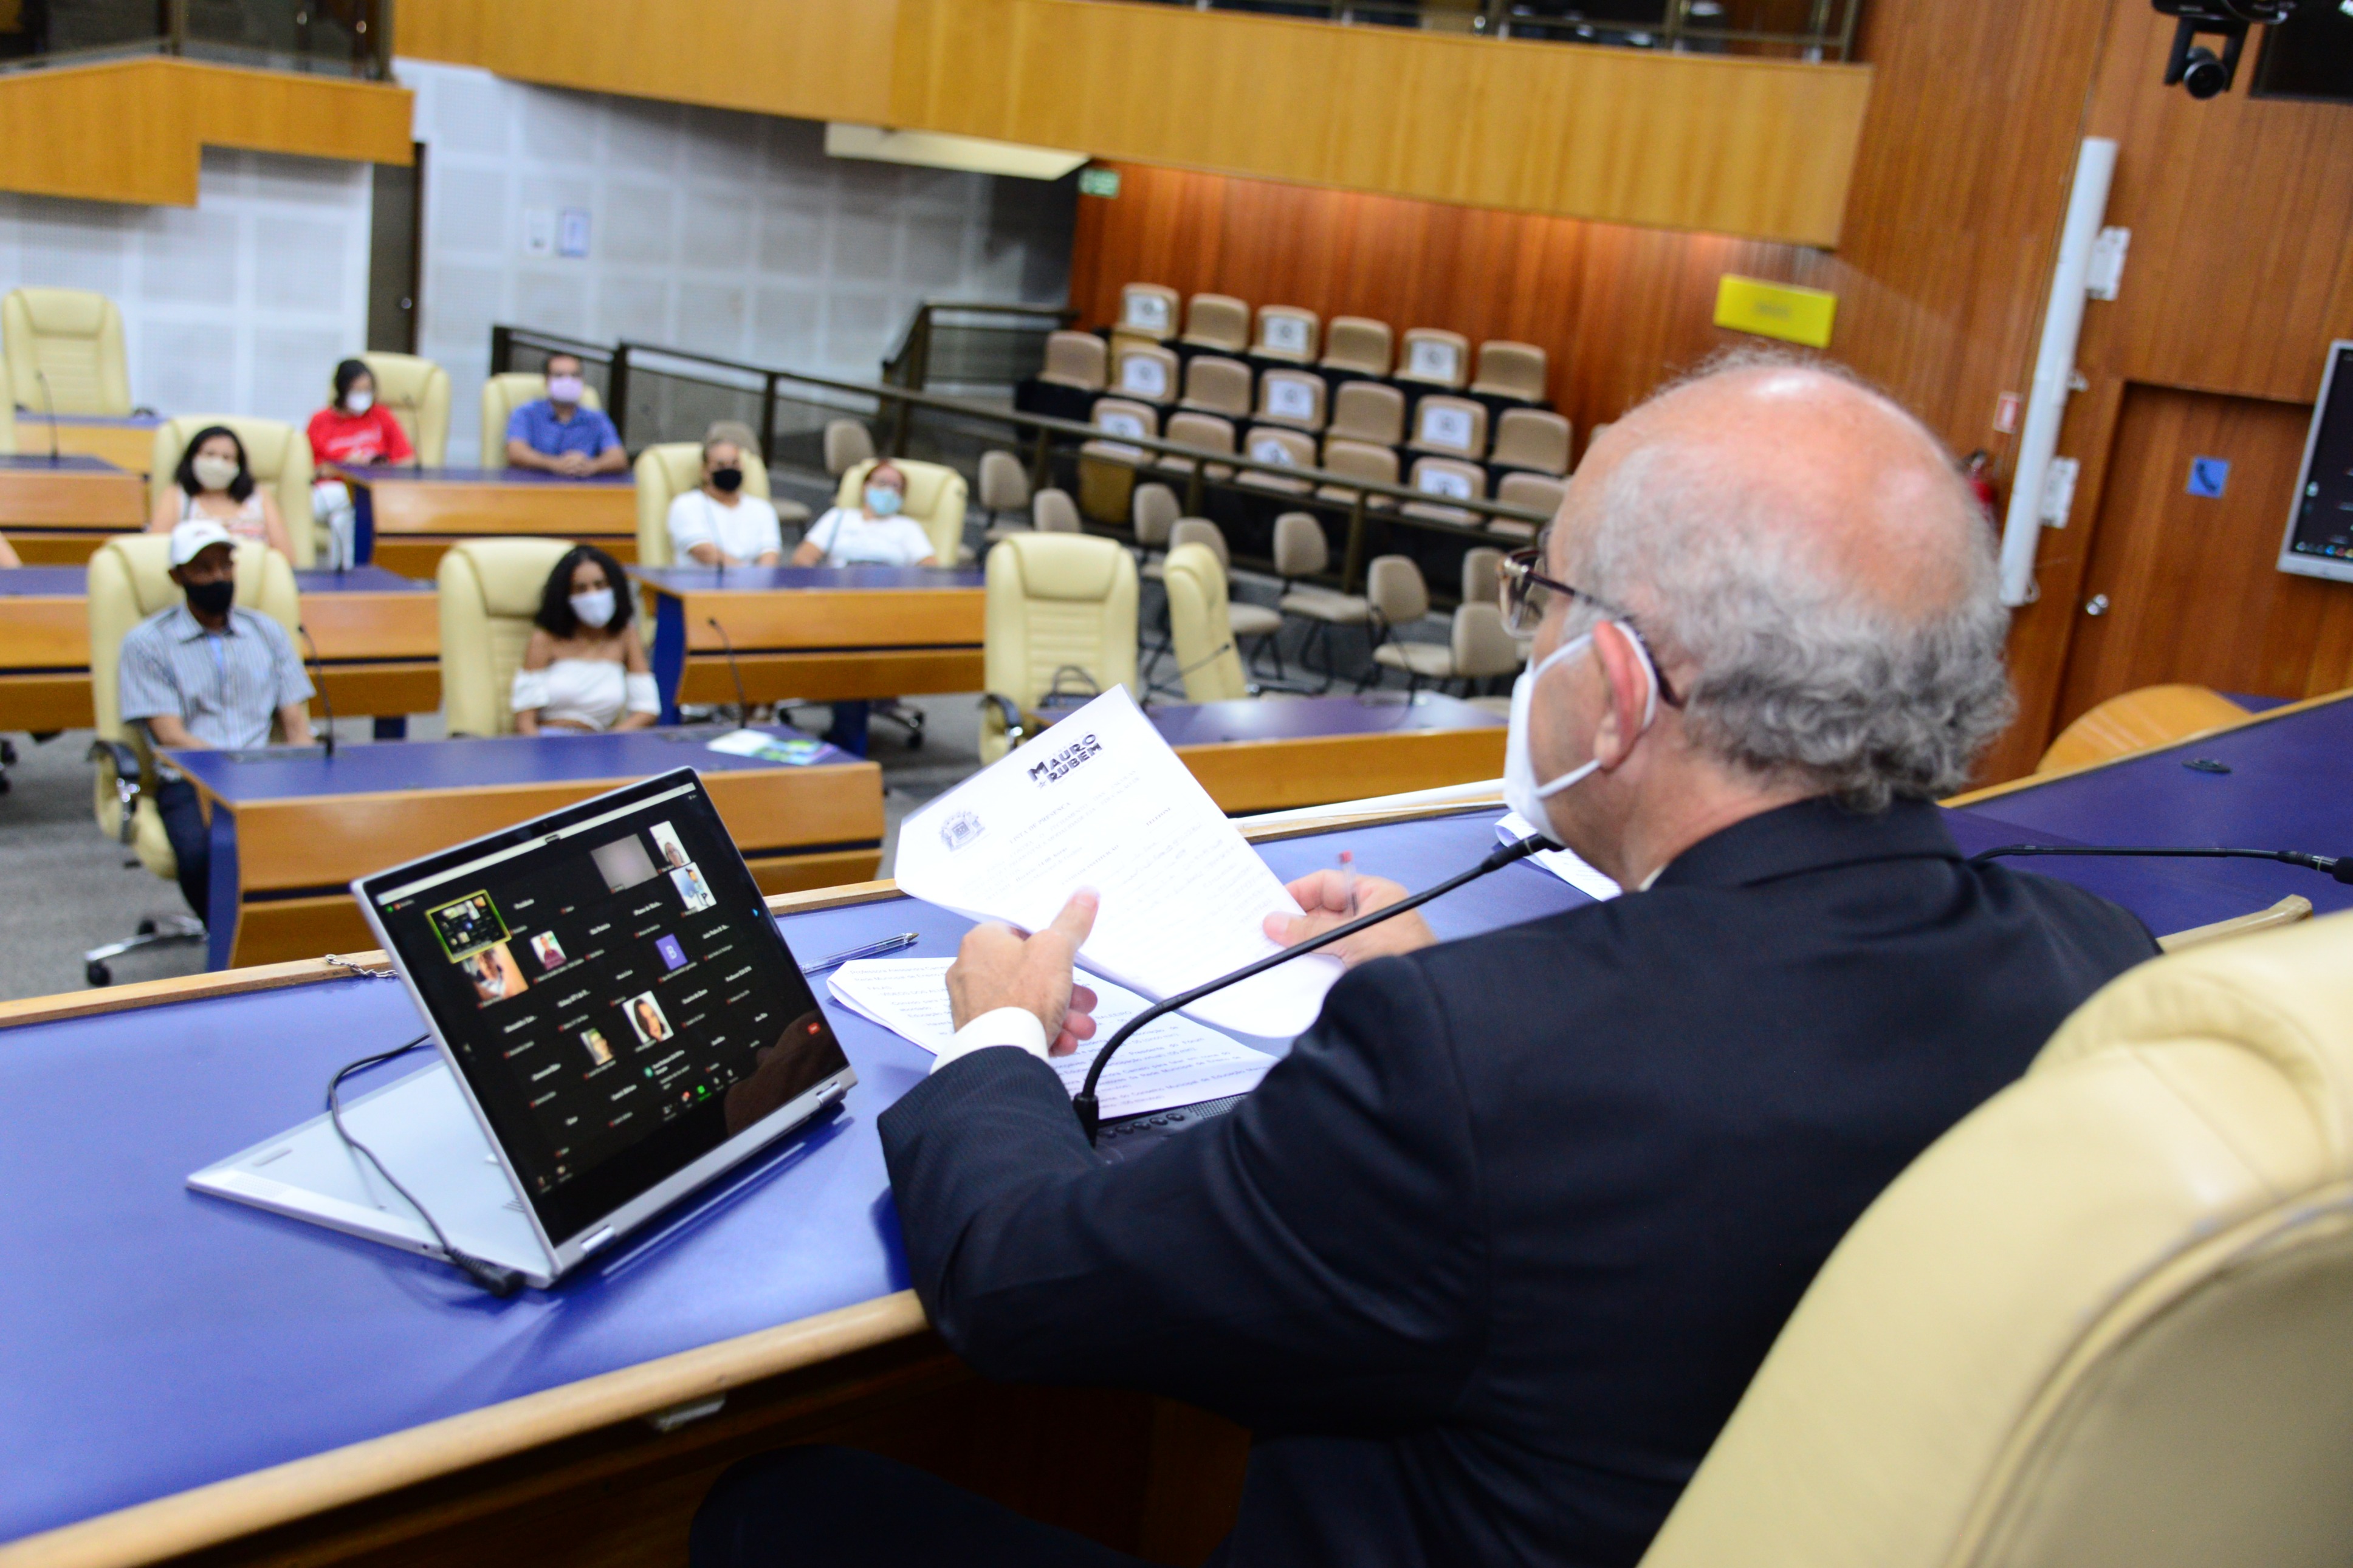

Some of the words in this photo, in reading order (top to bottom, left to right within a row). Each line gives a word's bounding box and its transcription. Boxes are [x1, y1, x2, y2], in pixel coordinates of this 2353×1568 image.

[1026, 734, 1096, 781] MAURO
[1046, 742, 1102, 783] RUBEM
[1028, 822, 1037, 831] DE
[665, 945, 677, 959] B
